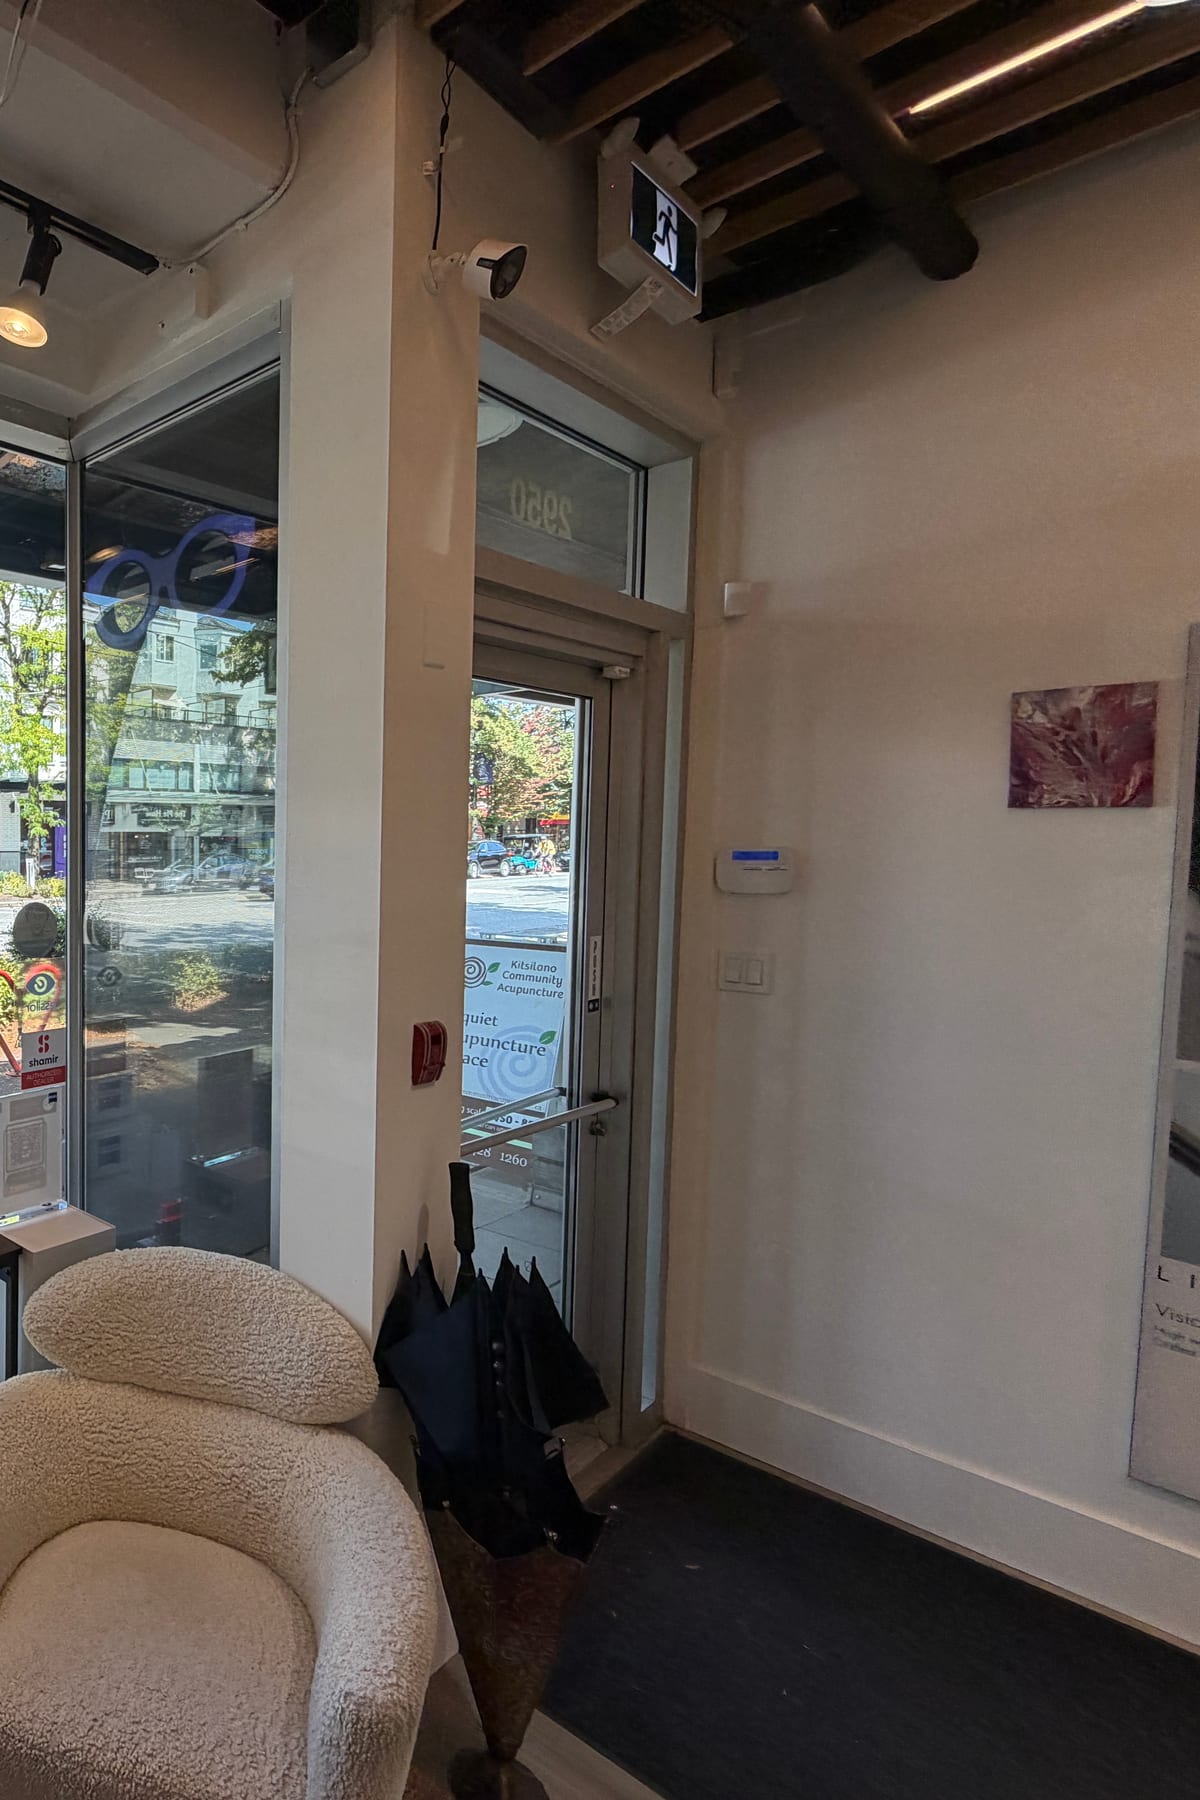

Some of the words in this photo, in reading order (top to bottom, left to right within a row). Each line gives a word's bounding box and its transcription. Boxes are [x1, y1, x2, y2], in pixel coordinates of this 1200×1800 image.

[510, 960, 557, 973] Kitsilano
[502, 970, 563, 988] Community
[497, 983, 564, 999] Acupuncture
[464, 1034, 546, 1056] puncture
[29, 1055, 59, 1067] shamir
[463, 1054, 489, 1068] ace
[500, 1152, 528, 1167] 1260
